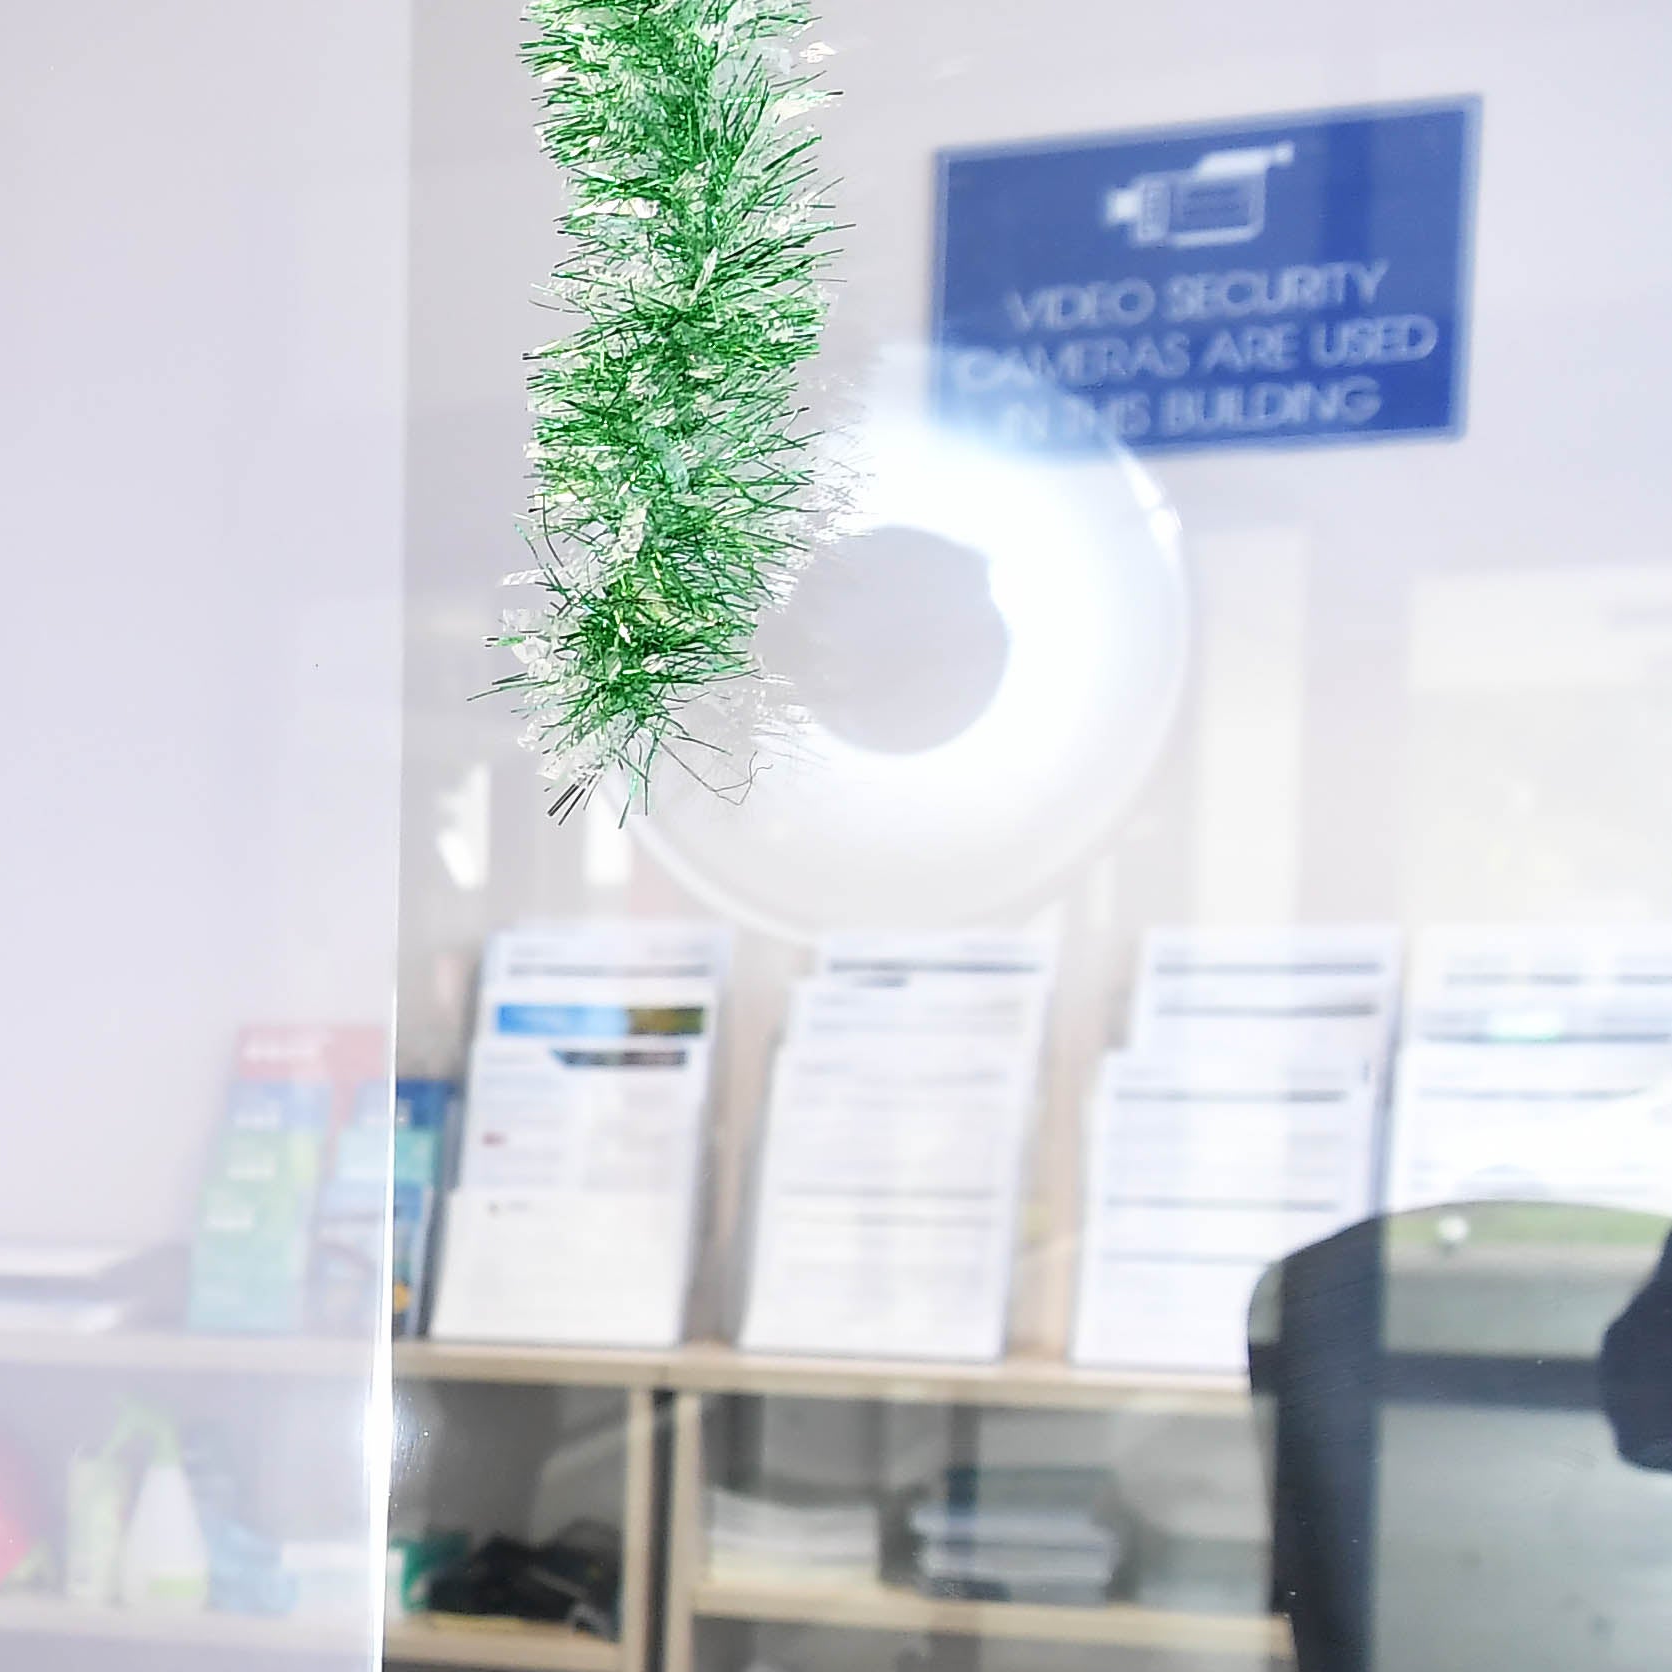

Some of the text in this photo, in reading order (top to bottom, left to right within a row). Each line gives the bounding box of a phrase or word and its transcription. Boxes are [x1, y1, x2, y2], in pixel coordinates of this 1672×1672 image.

[1004, 259, 1390, 331] VIDEO SECURITY
[958, 314, 1439, 393] CAMERAS ARE USED
[1160, 375, 1384, 434] BUILDING
